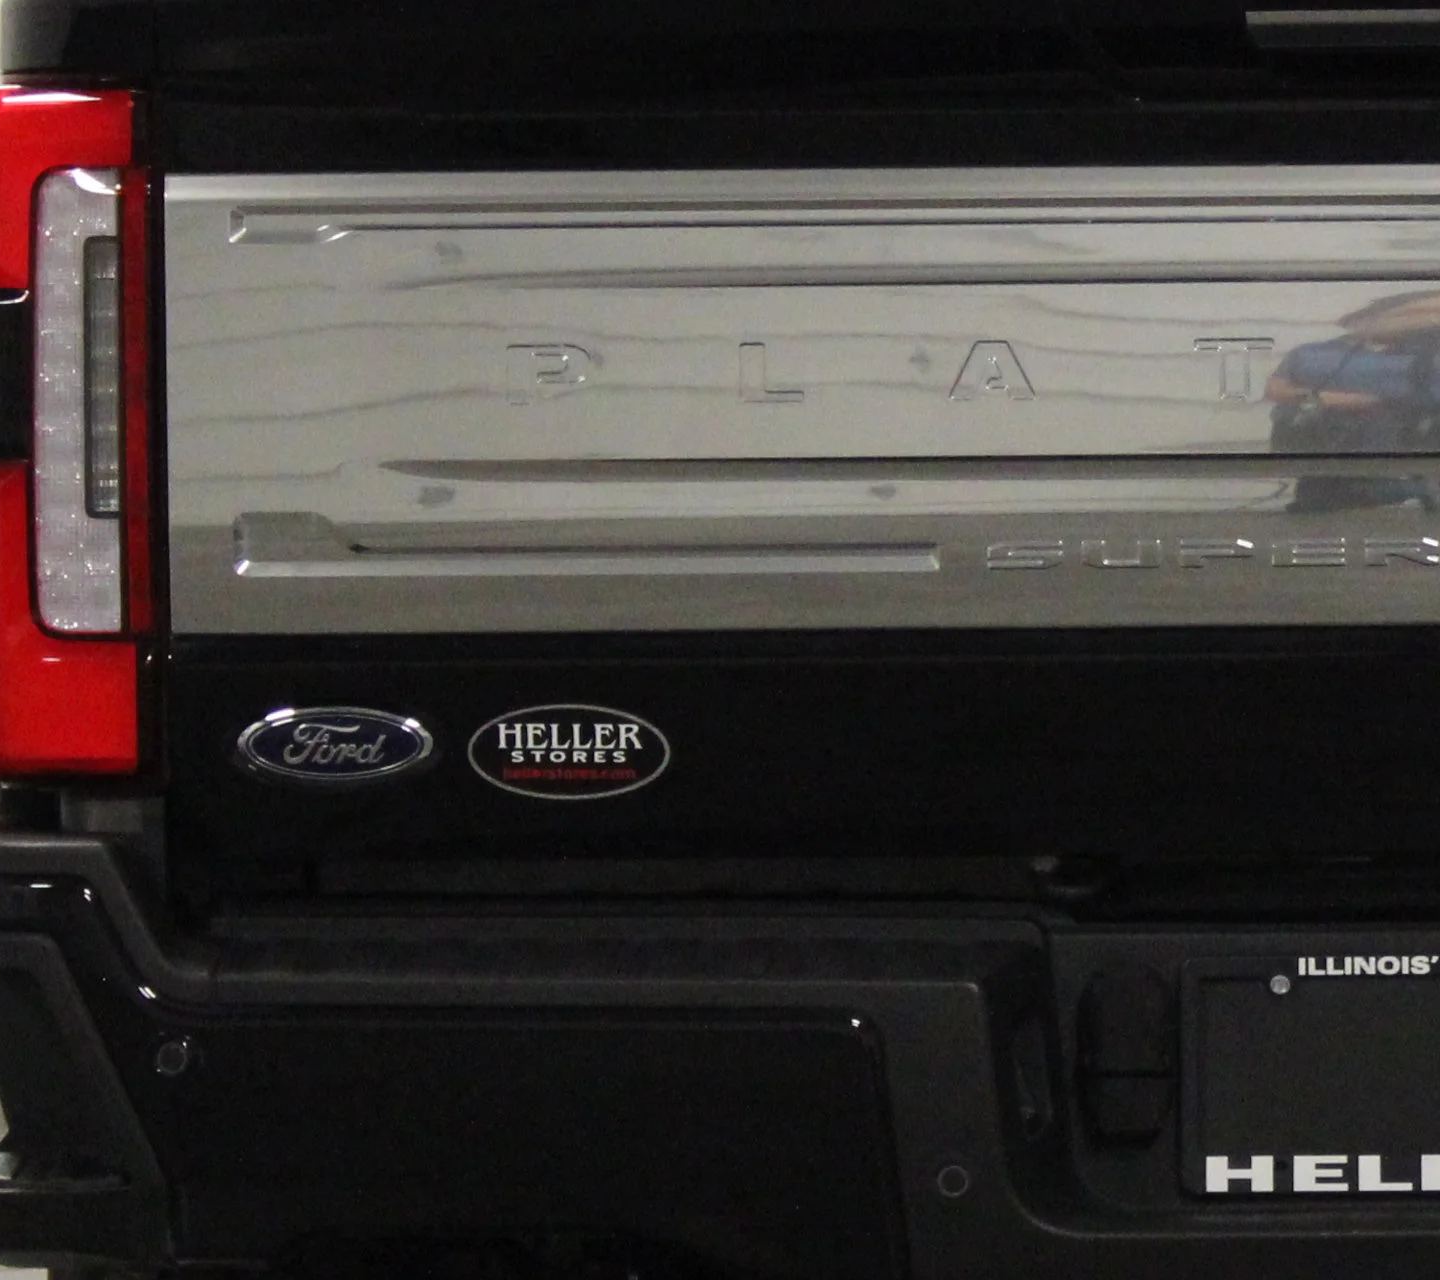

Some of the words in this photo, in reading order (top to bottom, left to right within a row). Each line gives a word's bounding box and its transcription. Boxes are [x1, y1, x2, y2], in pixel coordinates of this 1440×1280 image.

[985, 536, 1440, 569] SUPER
[282, 722, 386, 766] Ford
[497, 723, 643, 750] HELLER
[511, 750, 627, 763] STORES
